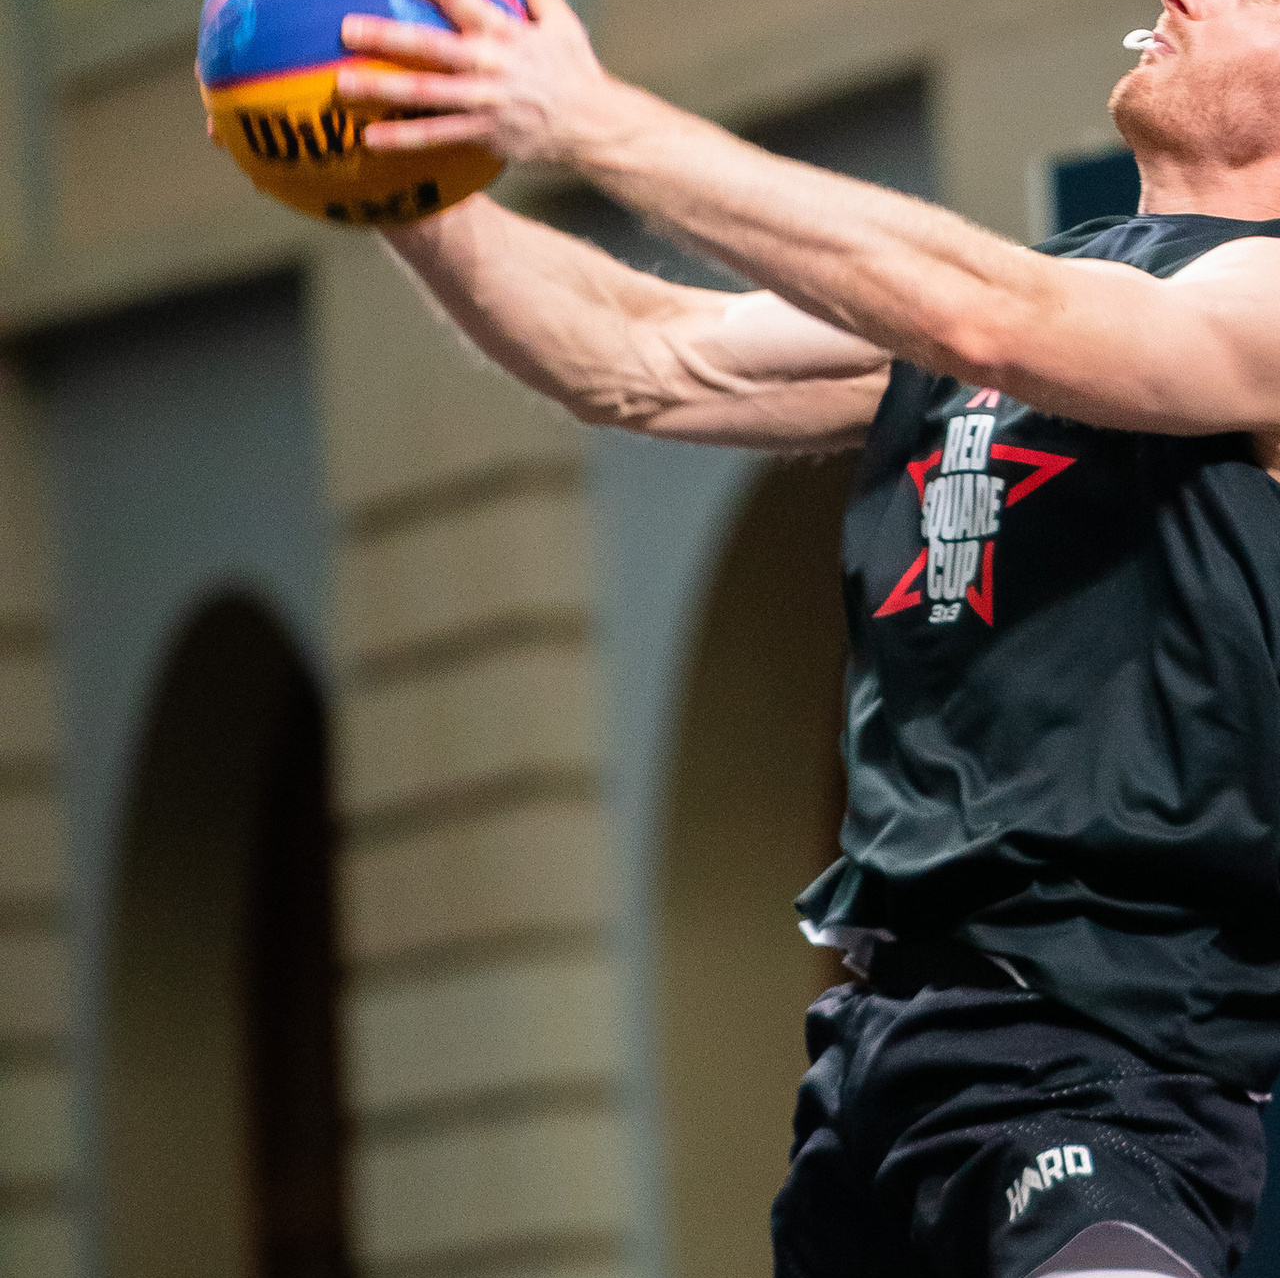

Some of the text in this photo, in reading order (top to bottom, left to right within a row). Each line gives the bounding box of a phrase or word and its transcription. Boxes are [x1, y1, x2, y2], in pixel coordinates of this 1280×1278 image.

[941, 413, 996, 473] RED
[927, 538, 980, 600] CUP
[1005, 1143, 1094, 1223] HARD
